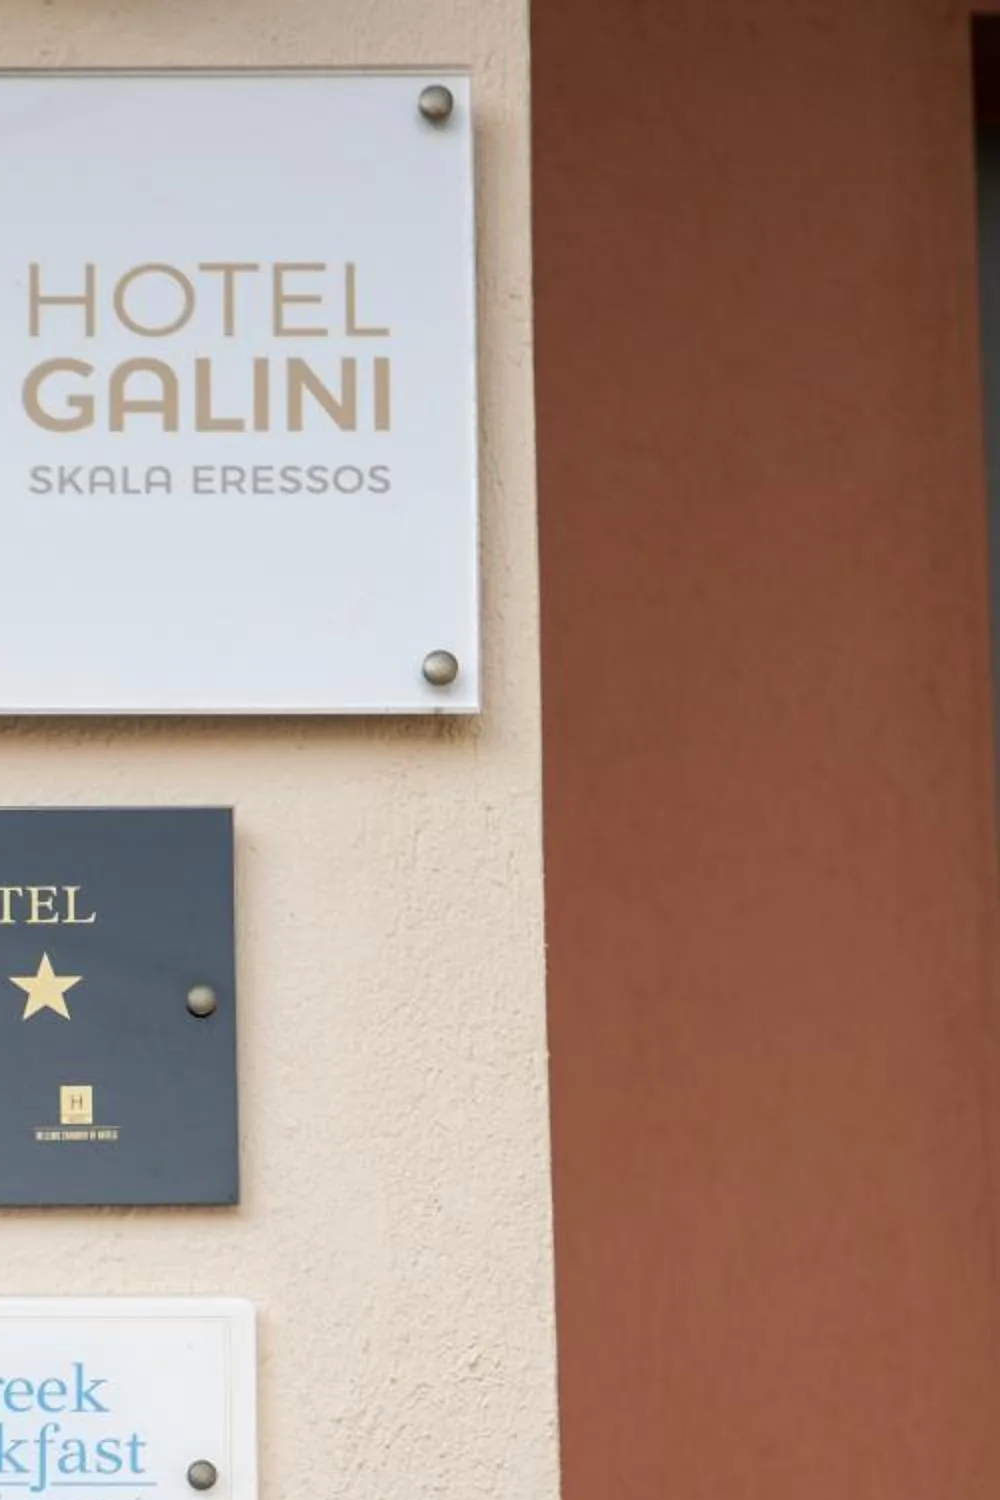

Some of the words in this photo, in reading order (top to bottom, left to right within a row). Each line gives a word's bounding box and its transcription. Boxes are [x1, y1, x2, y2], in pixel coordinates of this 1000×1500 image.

[27, 261, 391, 338] HOTEL
[21, 356, 391, 433] GALINI
[28, 465, 173, 495] SKALA
[192, 465, 392, 495] ERESSOS
